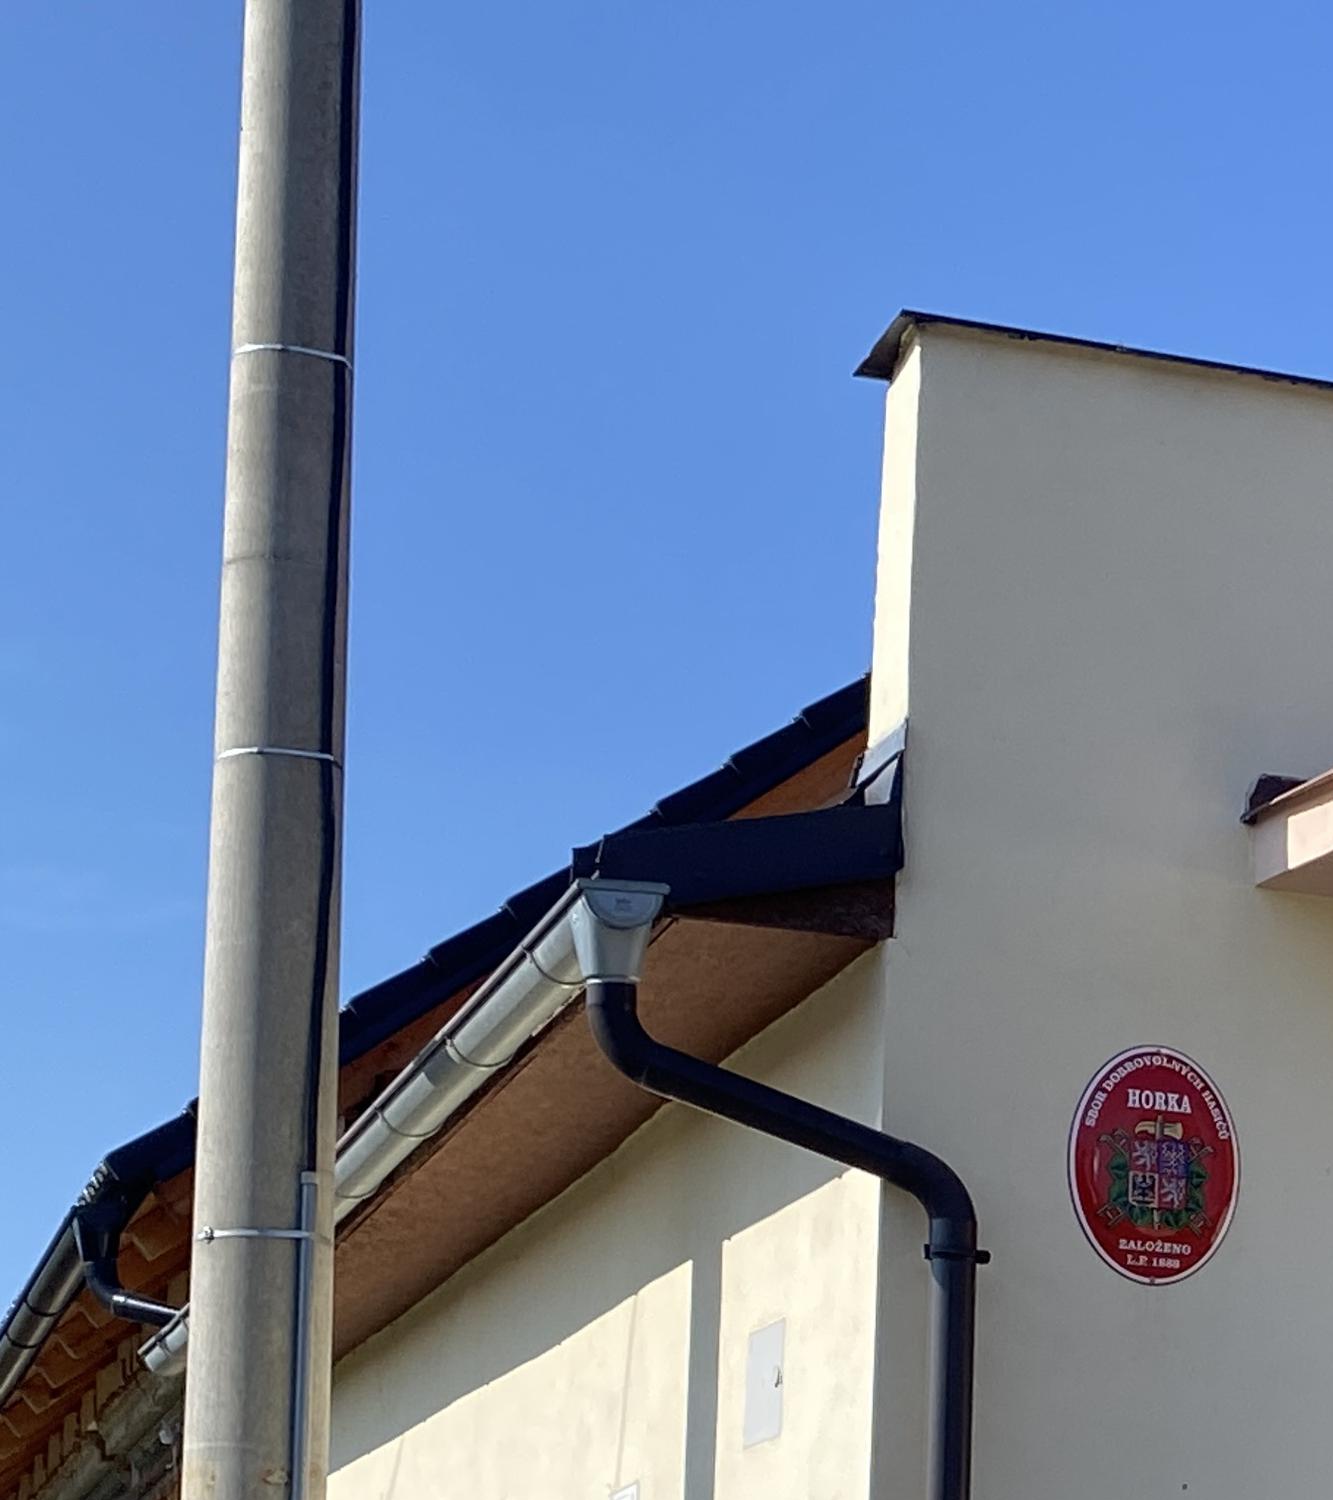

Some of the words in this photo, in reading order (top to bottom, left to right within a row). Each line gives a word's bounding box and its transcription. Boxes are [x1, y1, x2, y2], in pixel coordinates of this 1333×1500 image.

[1085, 1091, 1108, 1127] SBOR
[1127, 1088, 1192, 1114] HORKA
[1119, 1238, 1192, 1255] ZALOŽENO
